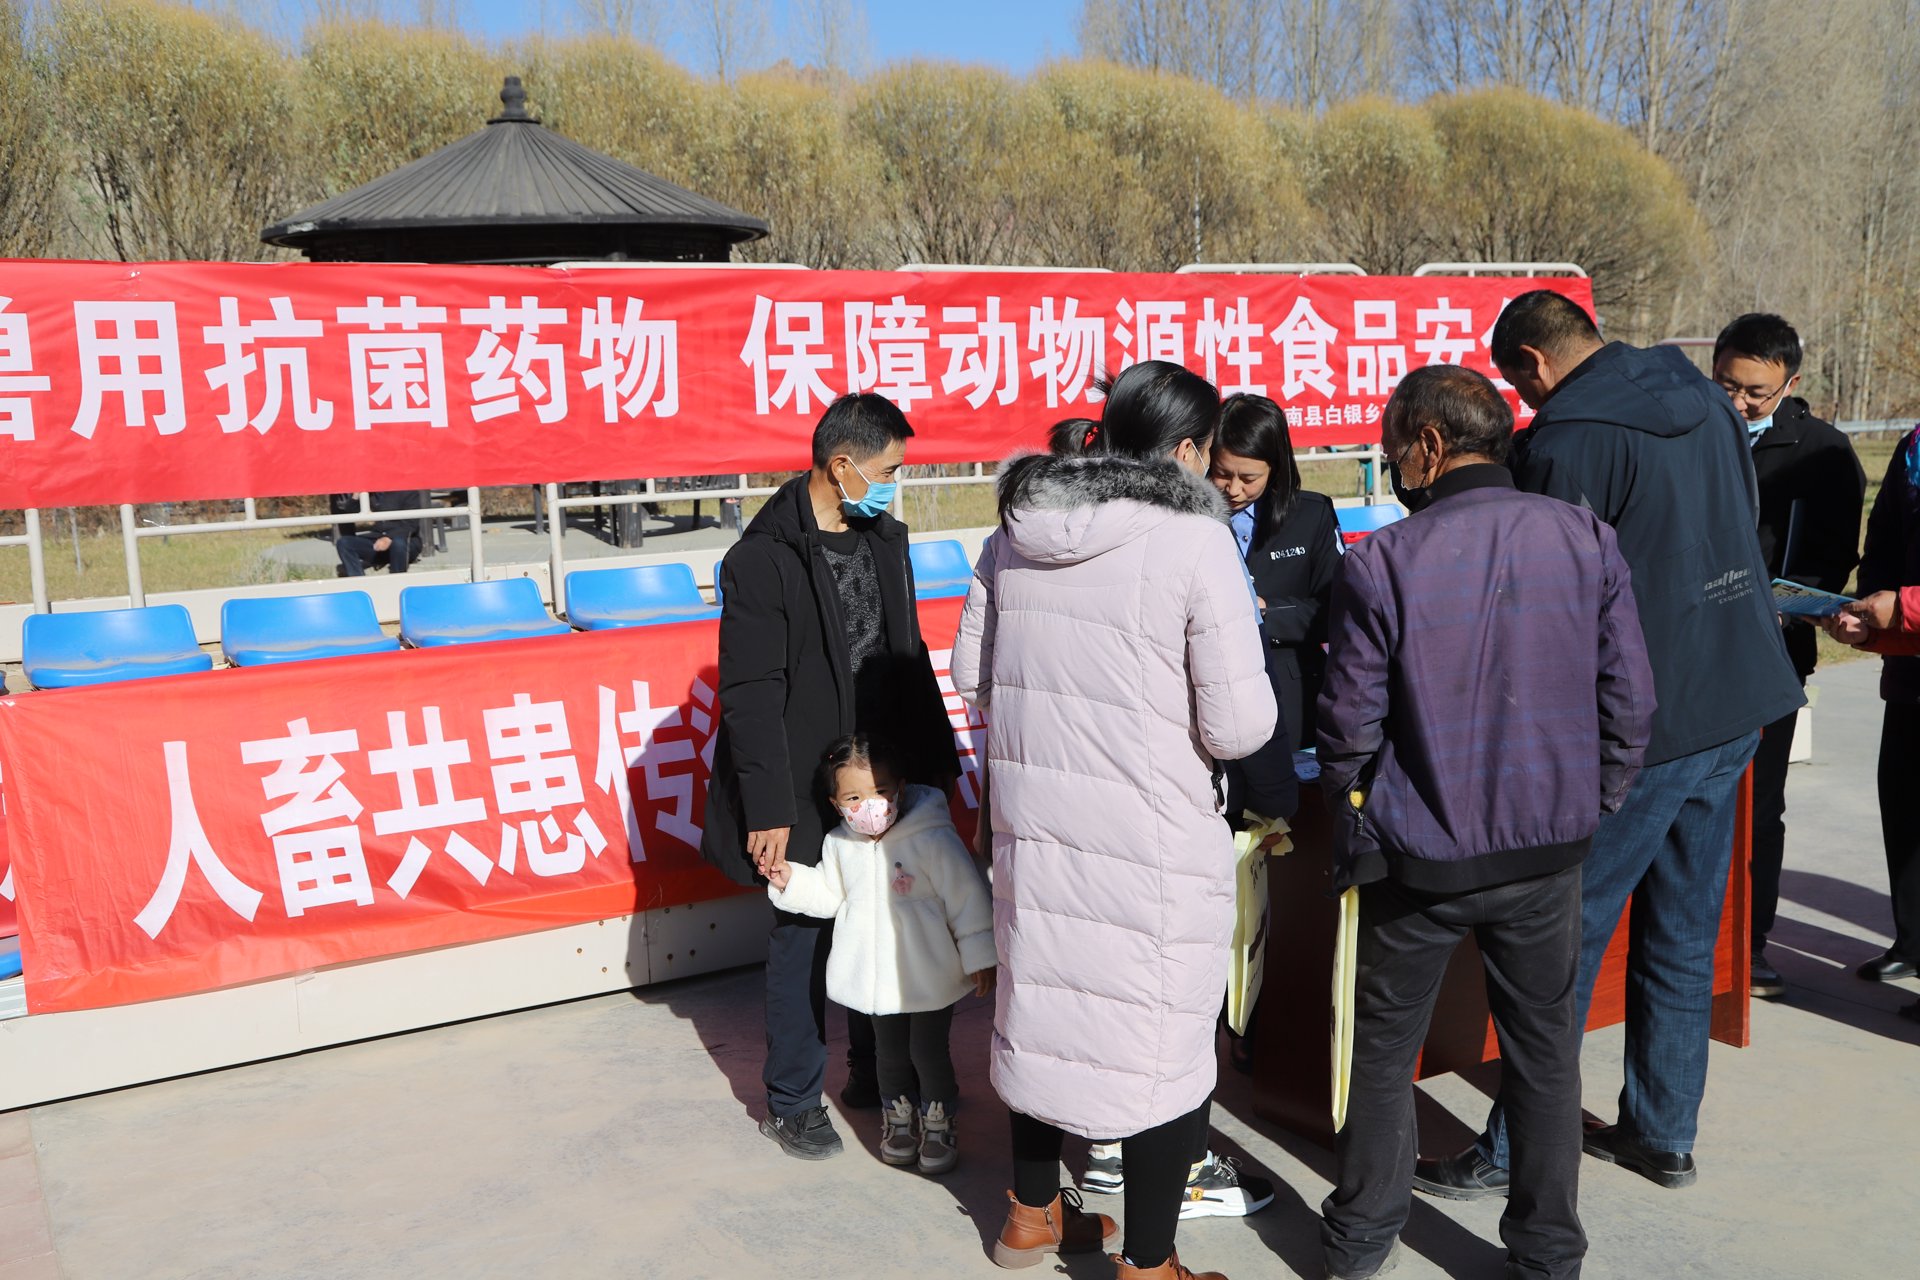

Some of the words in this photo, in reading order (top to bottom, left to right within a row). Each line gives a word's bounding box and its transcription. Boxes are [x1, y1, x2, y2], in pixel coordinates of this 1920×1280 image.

[739, 295, 1516, 414] 保障动物源性食品安
[1283, 403, 1387, 427] 南县白银乡
